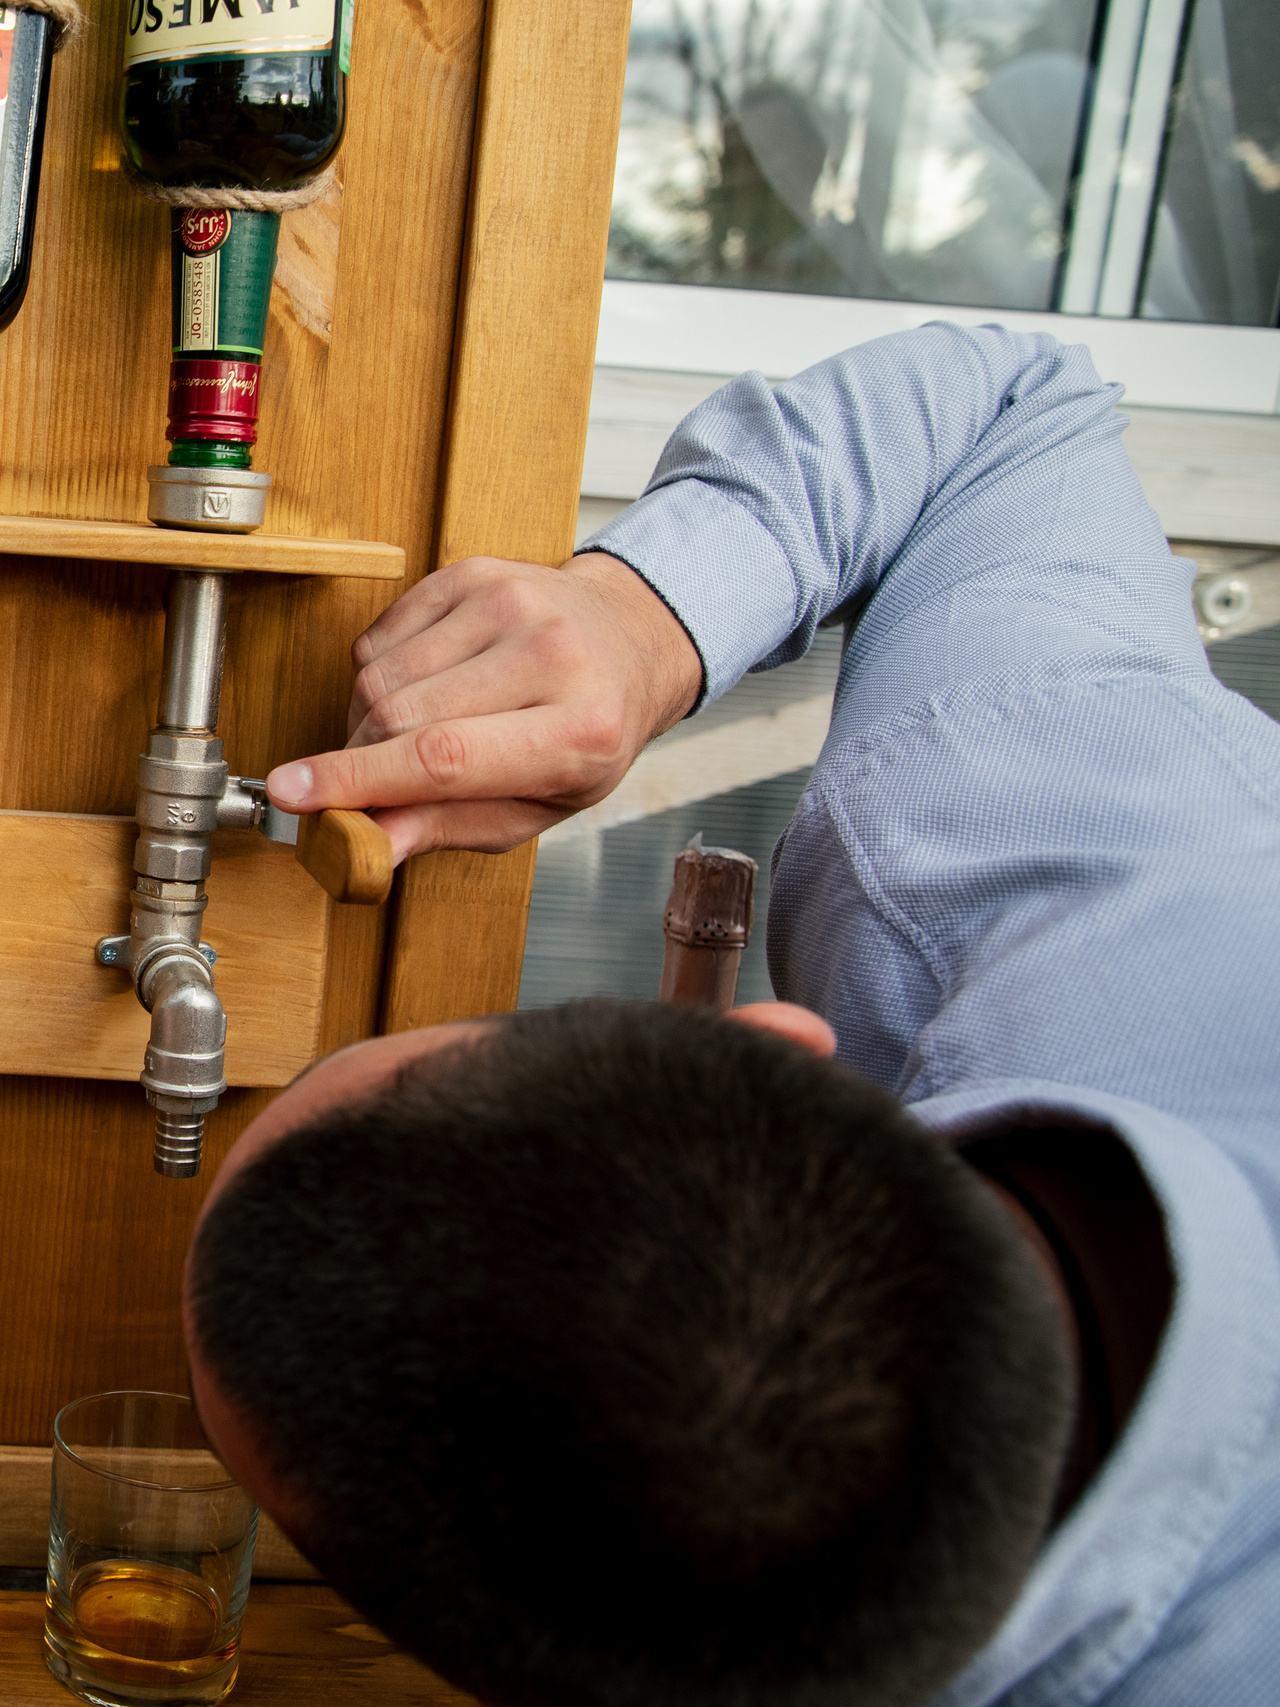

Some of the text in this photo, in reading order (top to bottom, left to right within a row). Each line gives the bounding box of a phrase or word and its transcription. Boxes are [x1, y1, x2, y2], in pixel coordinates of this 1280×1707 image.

[127, 0, 300, 36] MESO
[181, 225, 224, 251] JOHN JAMESON
[191, 261, 204, 339] JQ-058548
[231, 372, 258, 397] John
